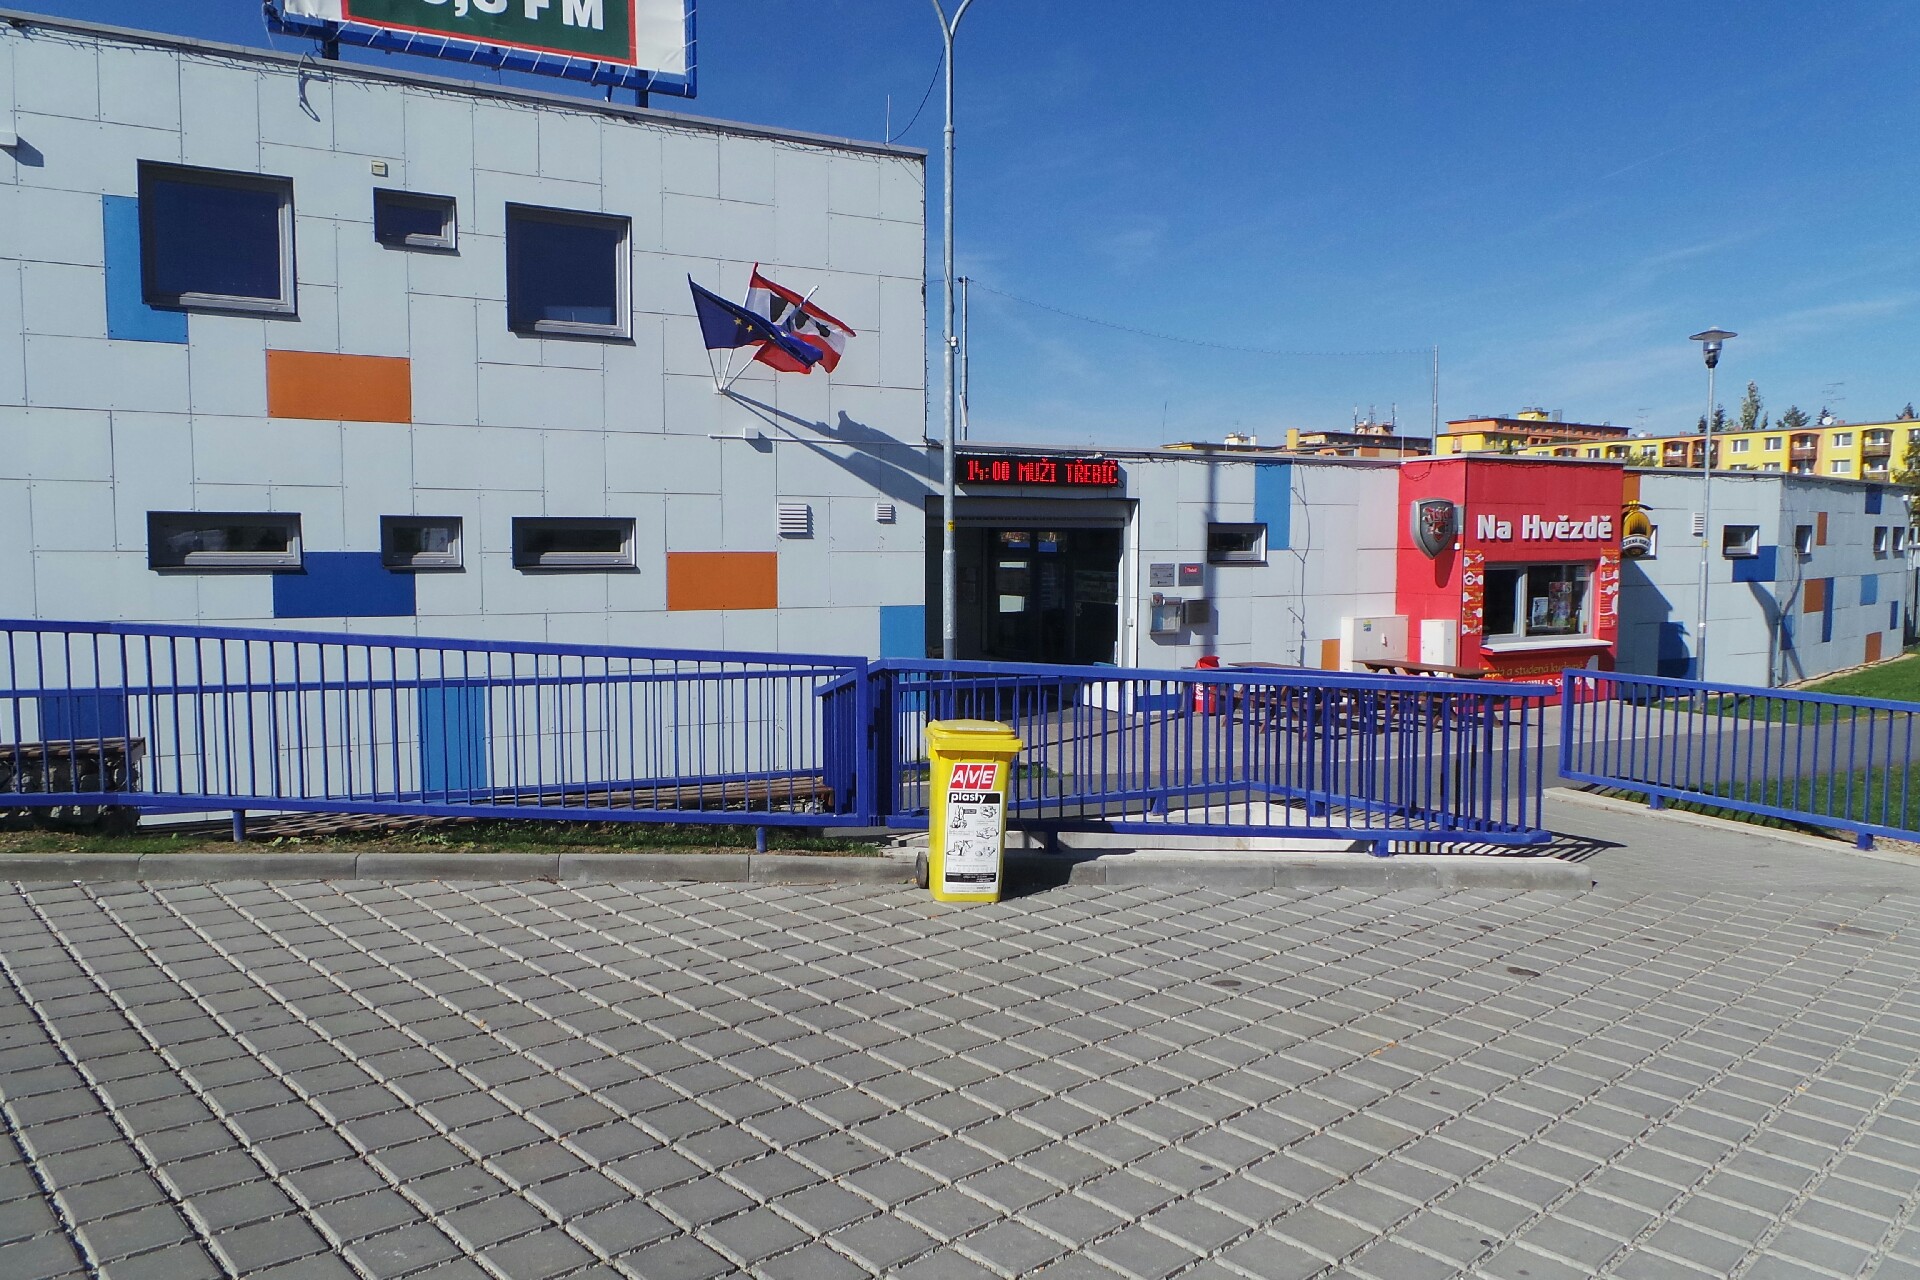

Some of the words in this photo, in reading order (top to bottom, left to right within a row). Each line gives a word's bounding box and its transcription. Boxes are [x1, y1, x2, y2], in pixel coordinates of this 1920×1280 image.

[967, 459, 1010, 481] 14:00
[1018, 458, 1057, 483] MUŽI
[1065, 459, 1118, 484] TŘEBÍČ
[1477, 514, 1512, 540] Na
[1522, 514, 1612, 540] Hvězdě
[1516, 664, 1549, 676] studená
[951, 769, 994, 784] AVE
[951, 792, 987, 804] plasty
